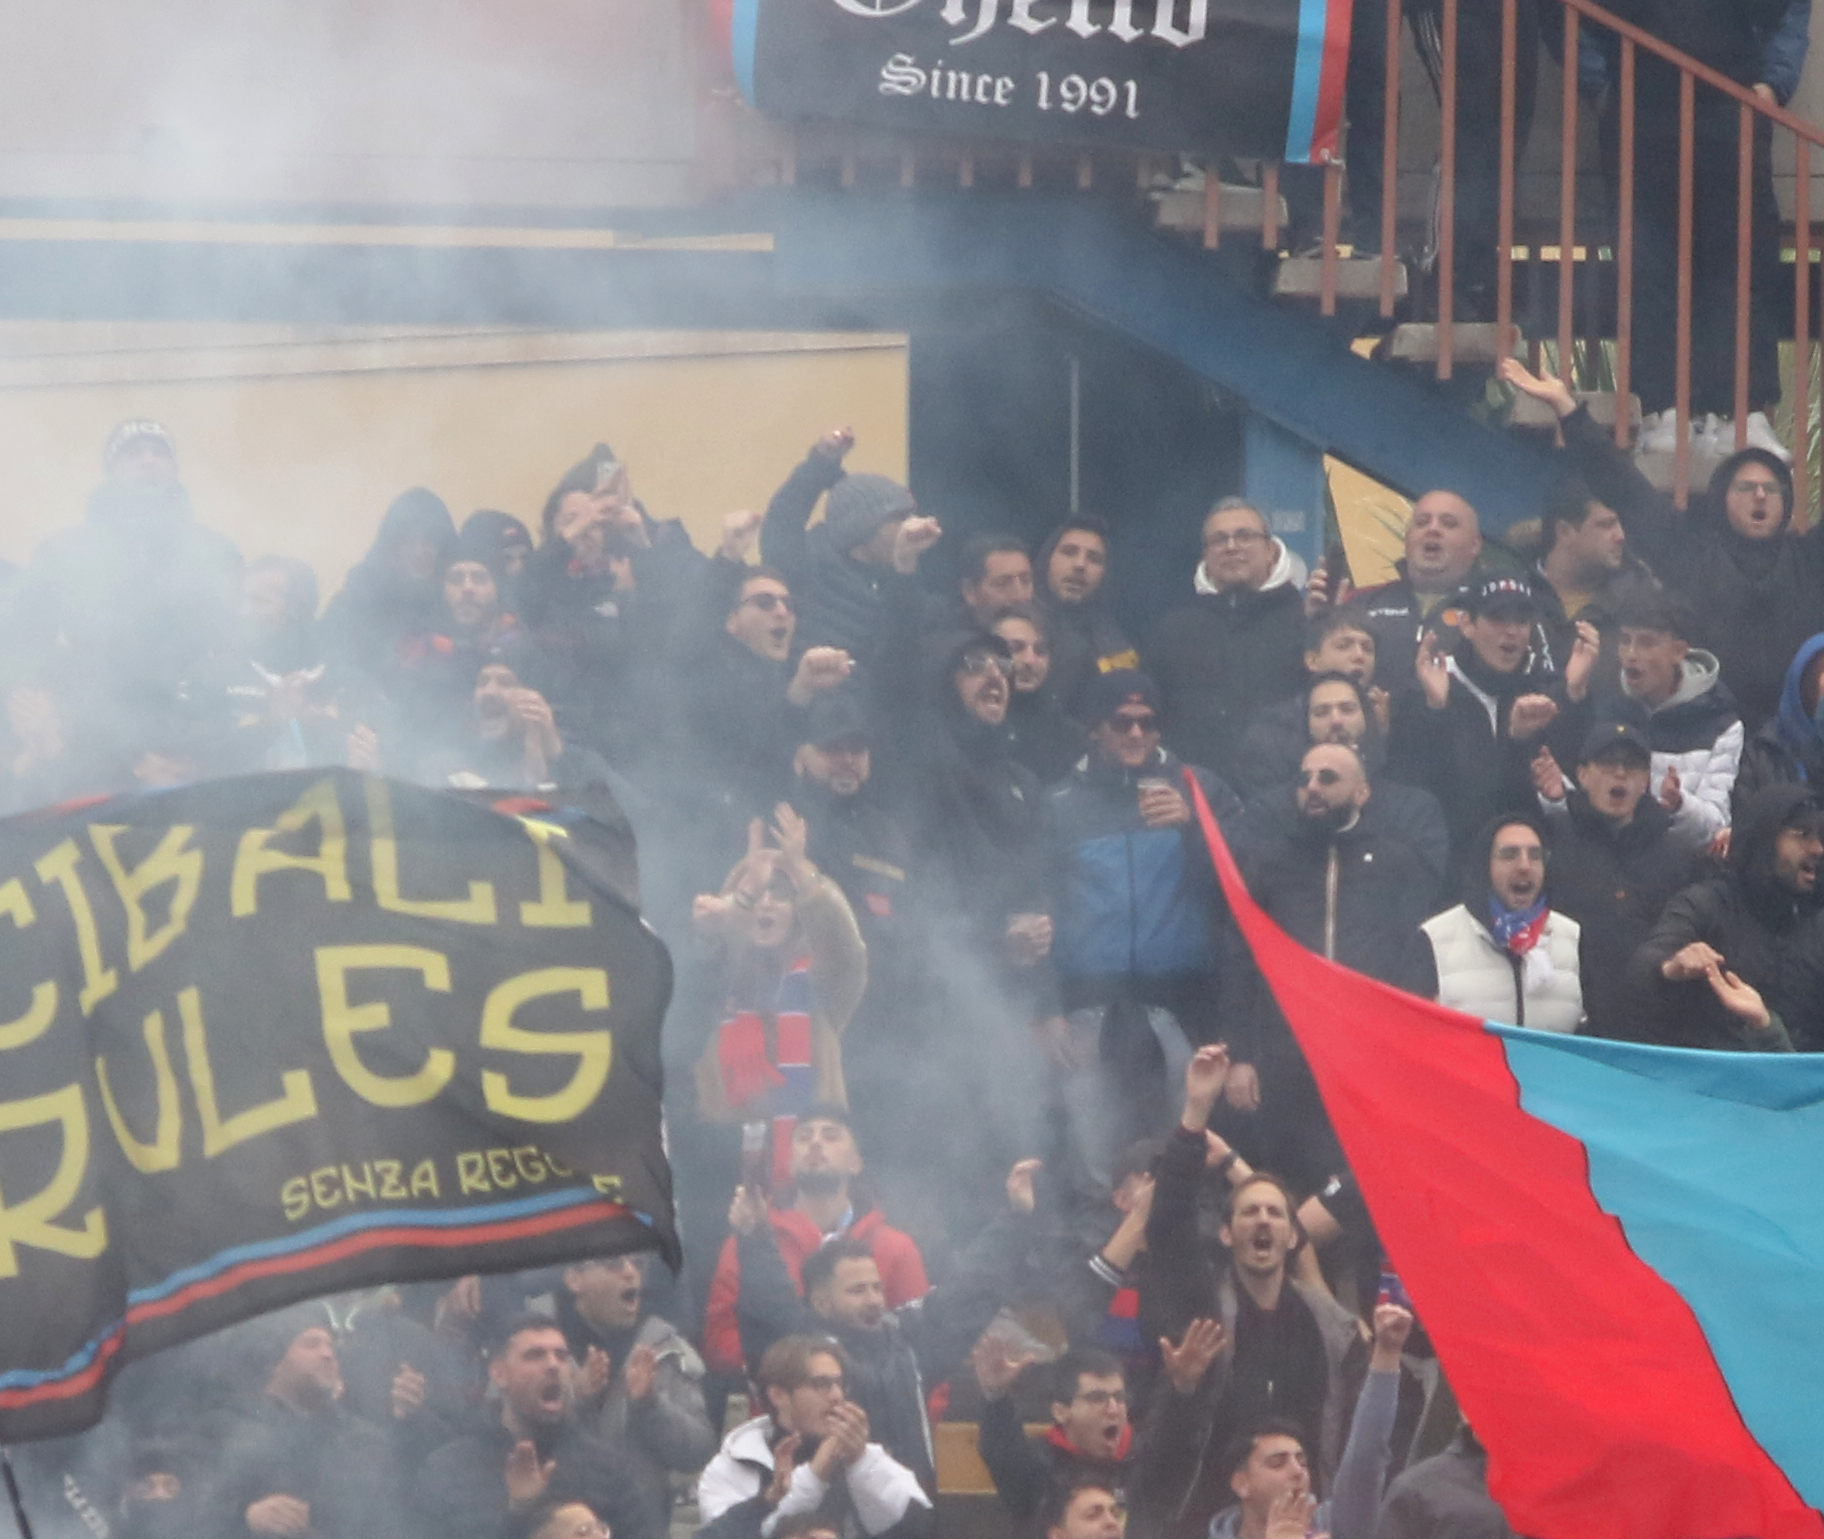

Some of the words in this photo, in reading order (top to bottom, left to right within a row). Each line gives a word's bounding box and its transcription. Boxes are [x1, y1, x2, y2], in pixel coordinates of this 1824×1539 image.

[878, 53, 1014, 106] Since
[1036, 71, 1140, 118] 1991
[281, 1158, 440, 1222] SENZA
